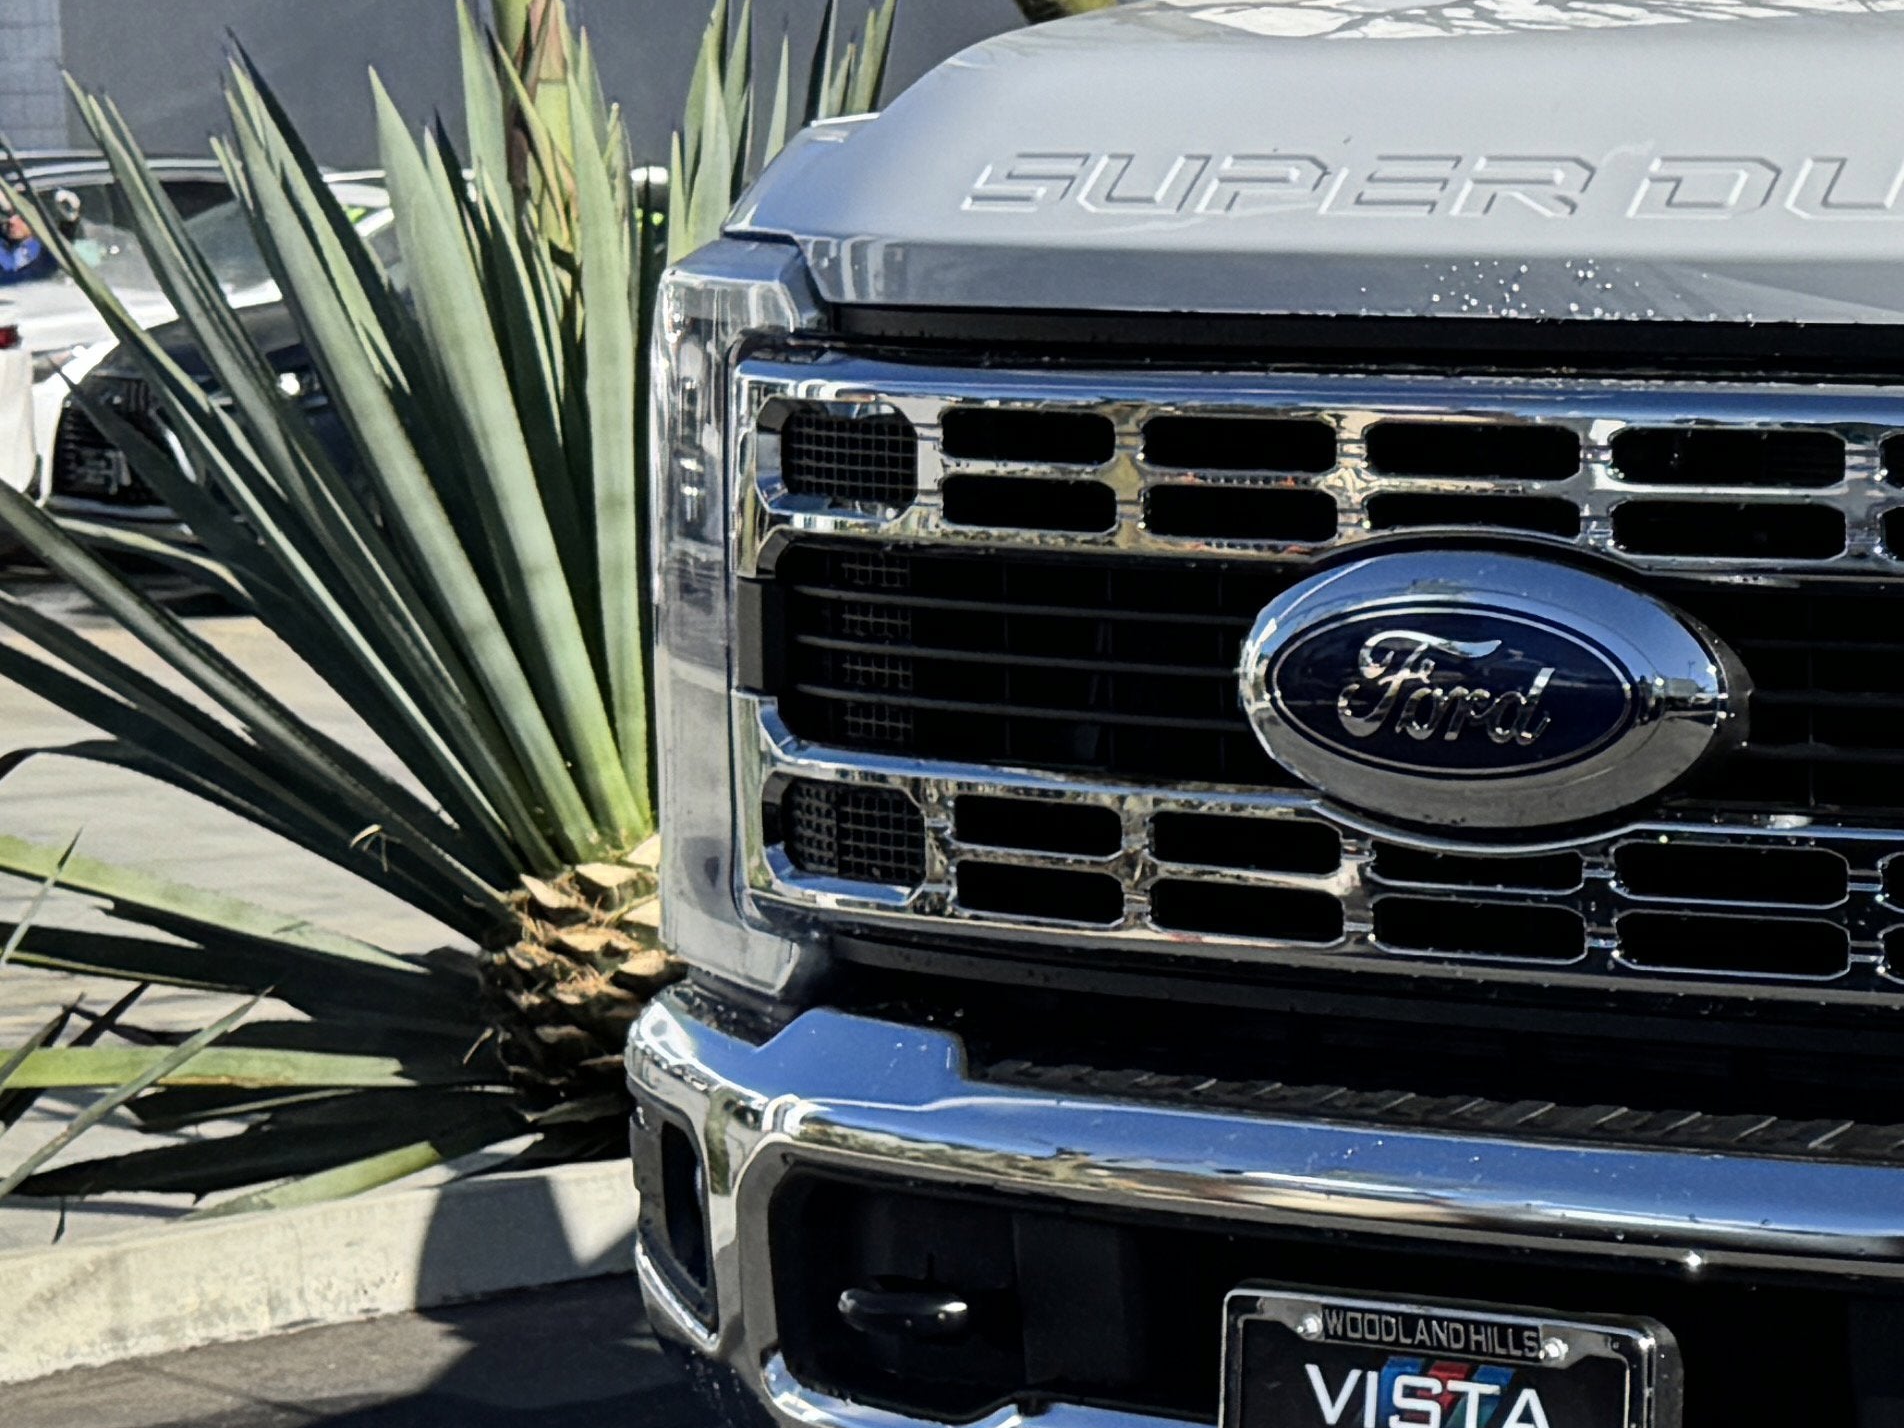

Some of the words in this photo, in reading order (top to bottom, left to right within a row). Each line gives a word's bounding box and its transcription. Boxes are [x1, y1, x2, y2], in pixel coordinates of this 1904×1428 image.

[960, 150, 1597, 217] SUPER
[1337, 629, 1555, 746] Ford
[1322, 1307, 1466, 1350] WOODLAND
[1468, 1323, 1541, 1359] HILLS
